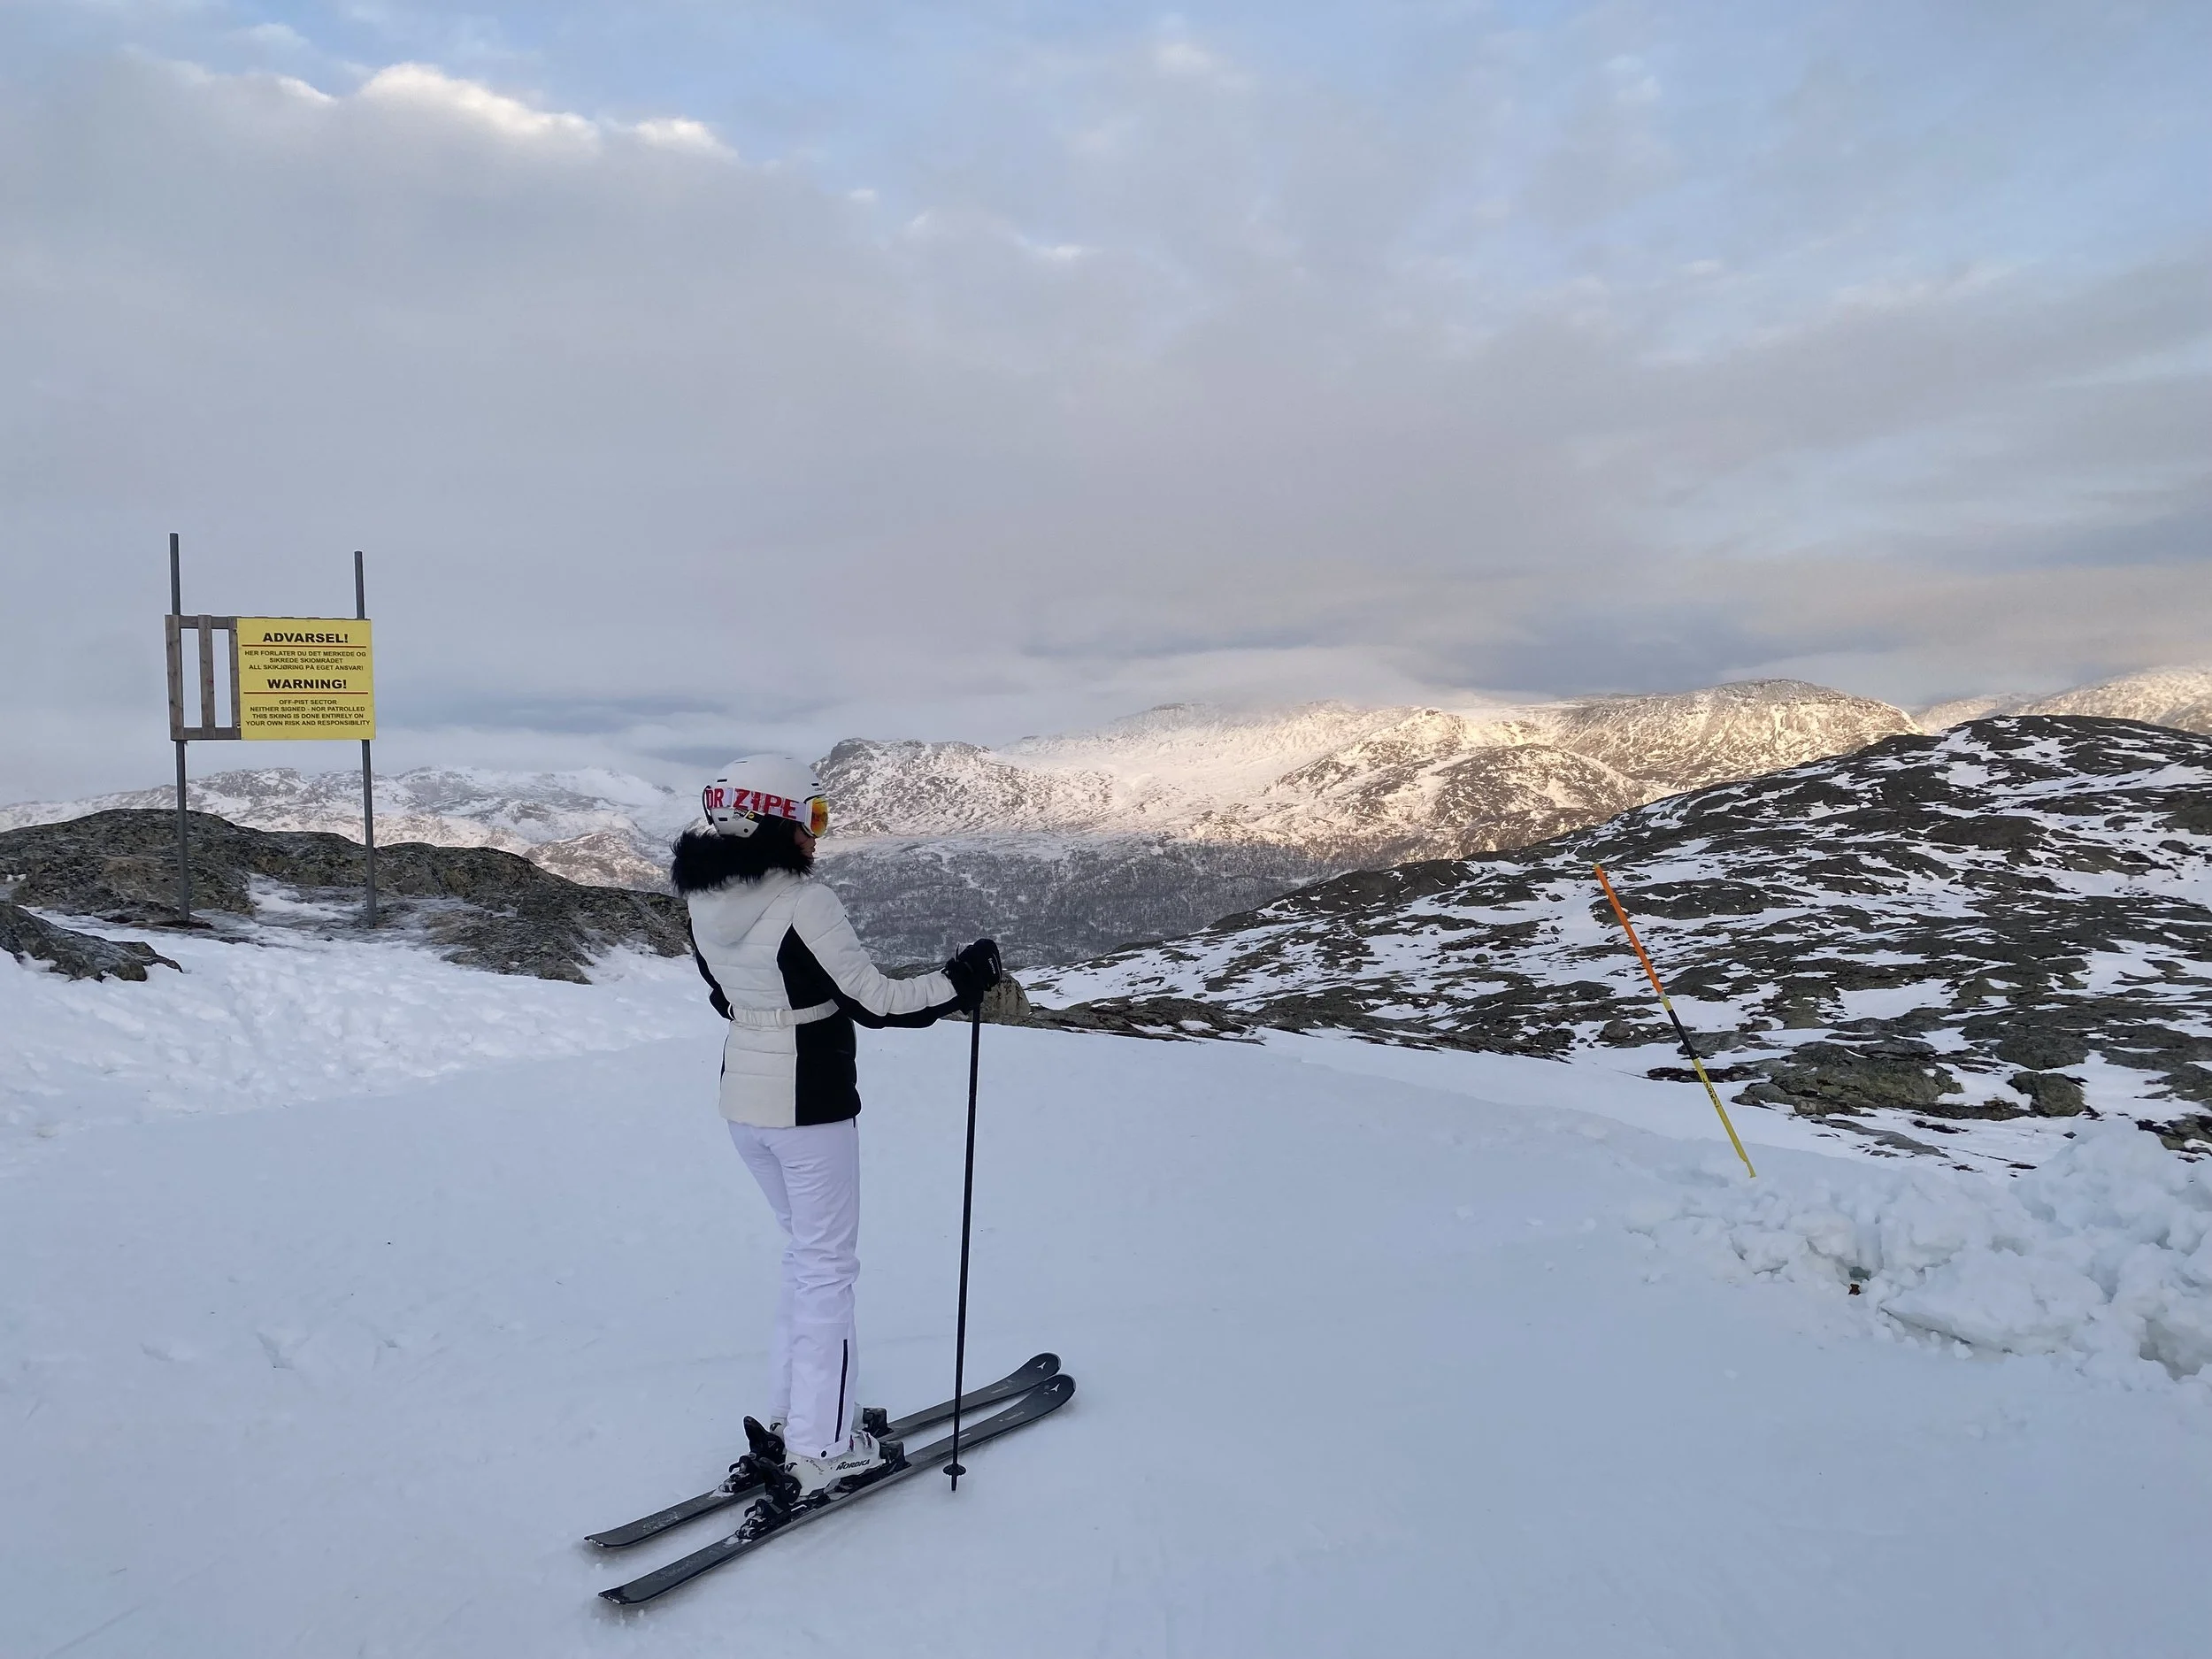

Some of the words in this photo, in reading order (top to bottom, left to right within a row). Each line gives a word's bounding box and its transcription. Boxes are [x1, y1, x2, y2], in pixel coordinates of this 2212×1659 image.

[262, 632, 349, 643] ADVARSEL!
[266, 679, 347, 689] WARNING!
[733, 787, 797, 819] ZIPE
[836, 1458, 871, 1471] NORDICA
